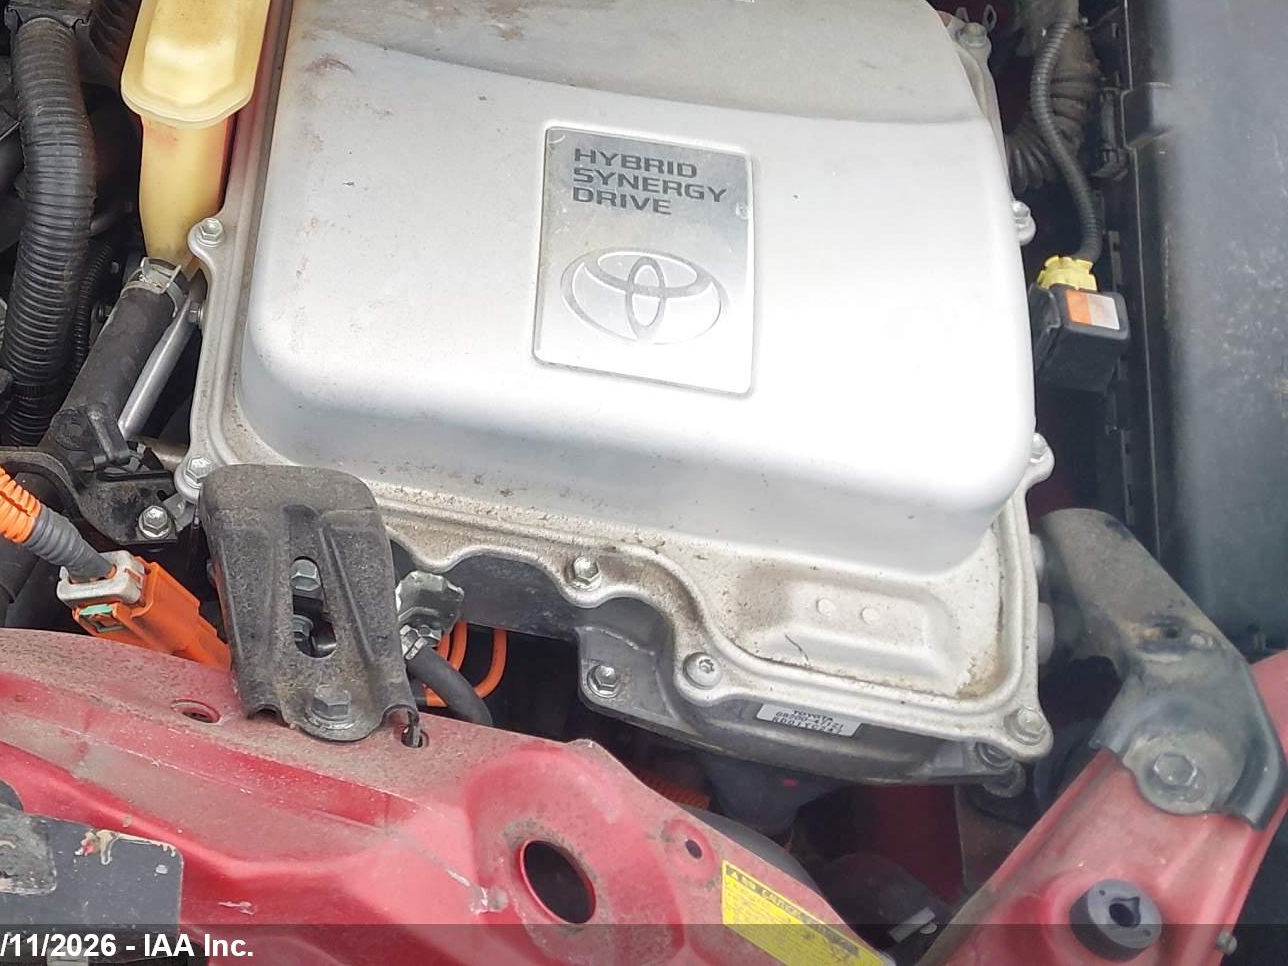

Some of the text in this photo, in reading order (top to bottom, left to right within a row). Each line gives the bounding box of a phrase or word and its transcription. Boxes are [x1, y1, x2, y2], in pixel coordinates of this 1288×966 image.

[574, 148, 698, 179] HYBRID
[572, 168, 728, 203] SYNERGY
[572, 187, 672, 216] DRIVE
[793, 710, 834, 721] TOYOTA
